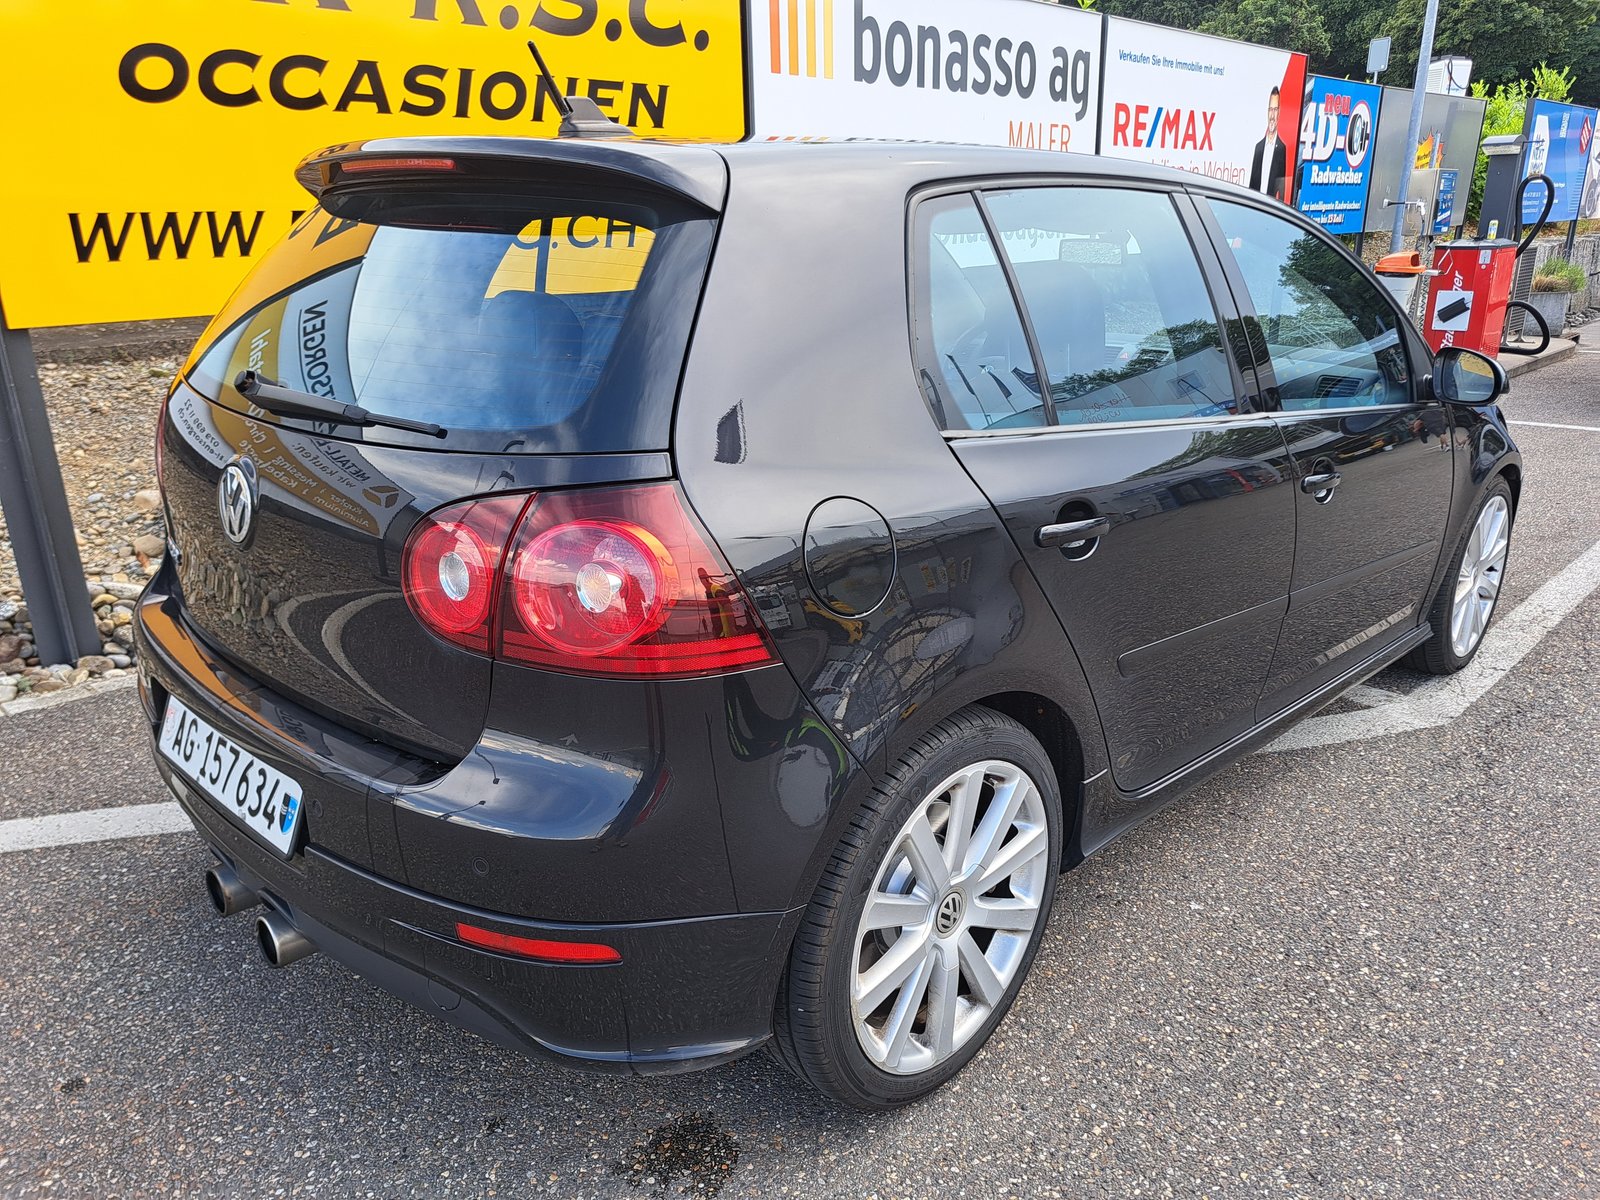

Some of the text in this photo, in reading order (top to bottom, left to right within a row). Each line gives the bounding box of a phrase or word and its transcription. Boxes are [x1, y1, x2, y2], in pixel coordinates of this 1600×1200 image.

[118, 42, 670, 129] OCCASIONEN
[854, 0, 1091, 122] bonasso ag
[1118, 49, 1151, 65] Verkaufen
[1151, 54, 1162, 66] Sie
[1162, 56, 1175, 69] Ihre
[1175, 59, 1203, 72] Immobilie
[1203, 65, 1213, 74] mit
[1112, 102, 1216, 151] RE/MAX
[1324, 93, 1351, 115] neu
[1310, 165, 1363, 185] Radwäscher
[171, 709, 199, 763] AG
